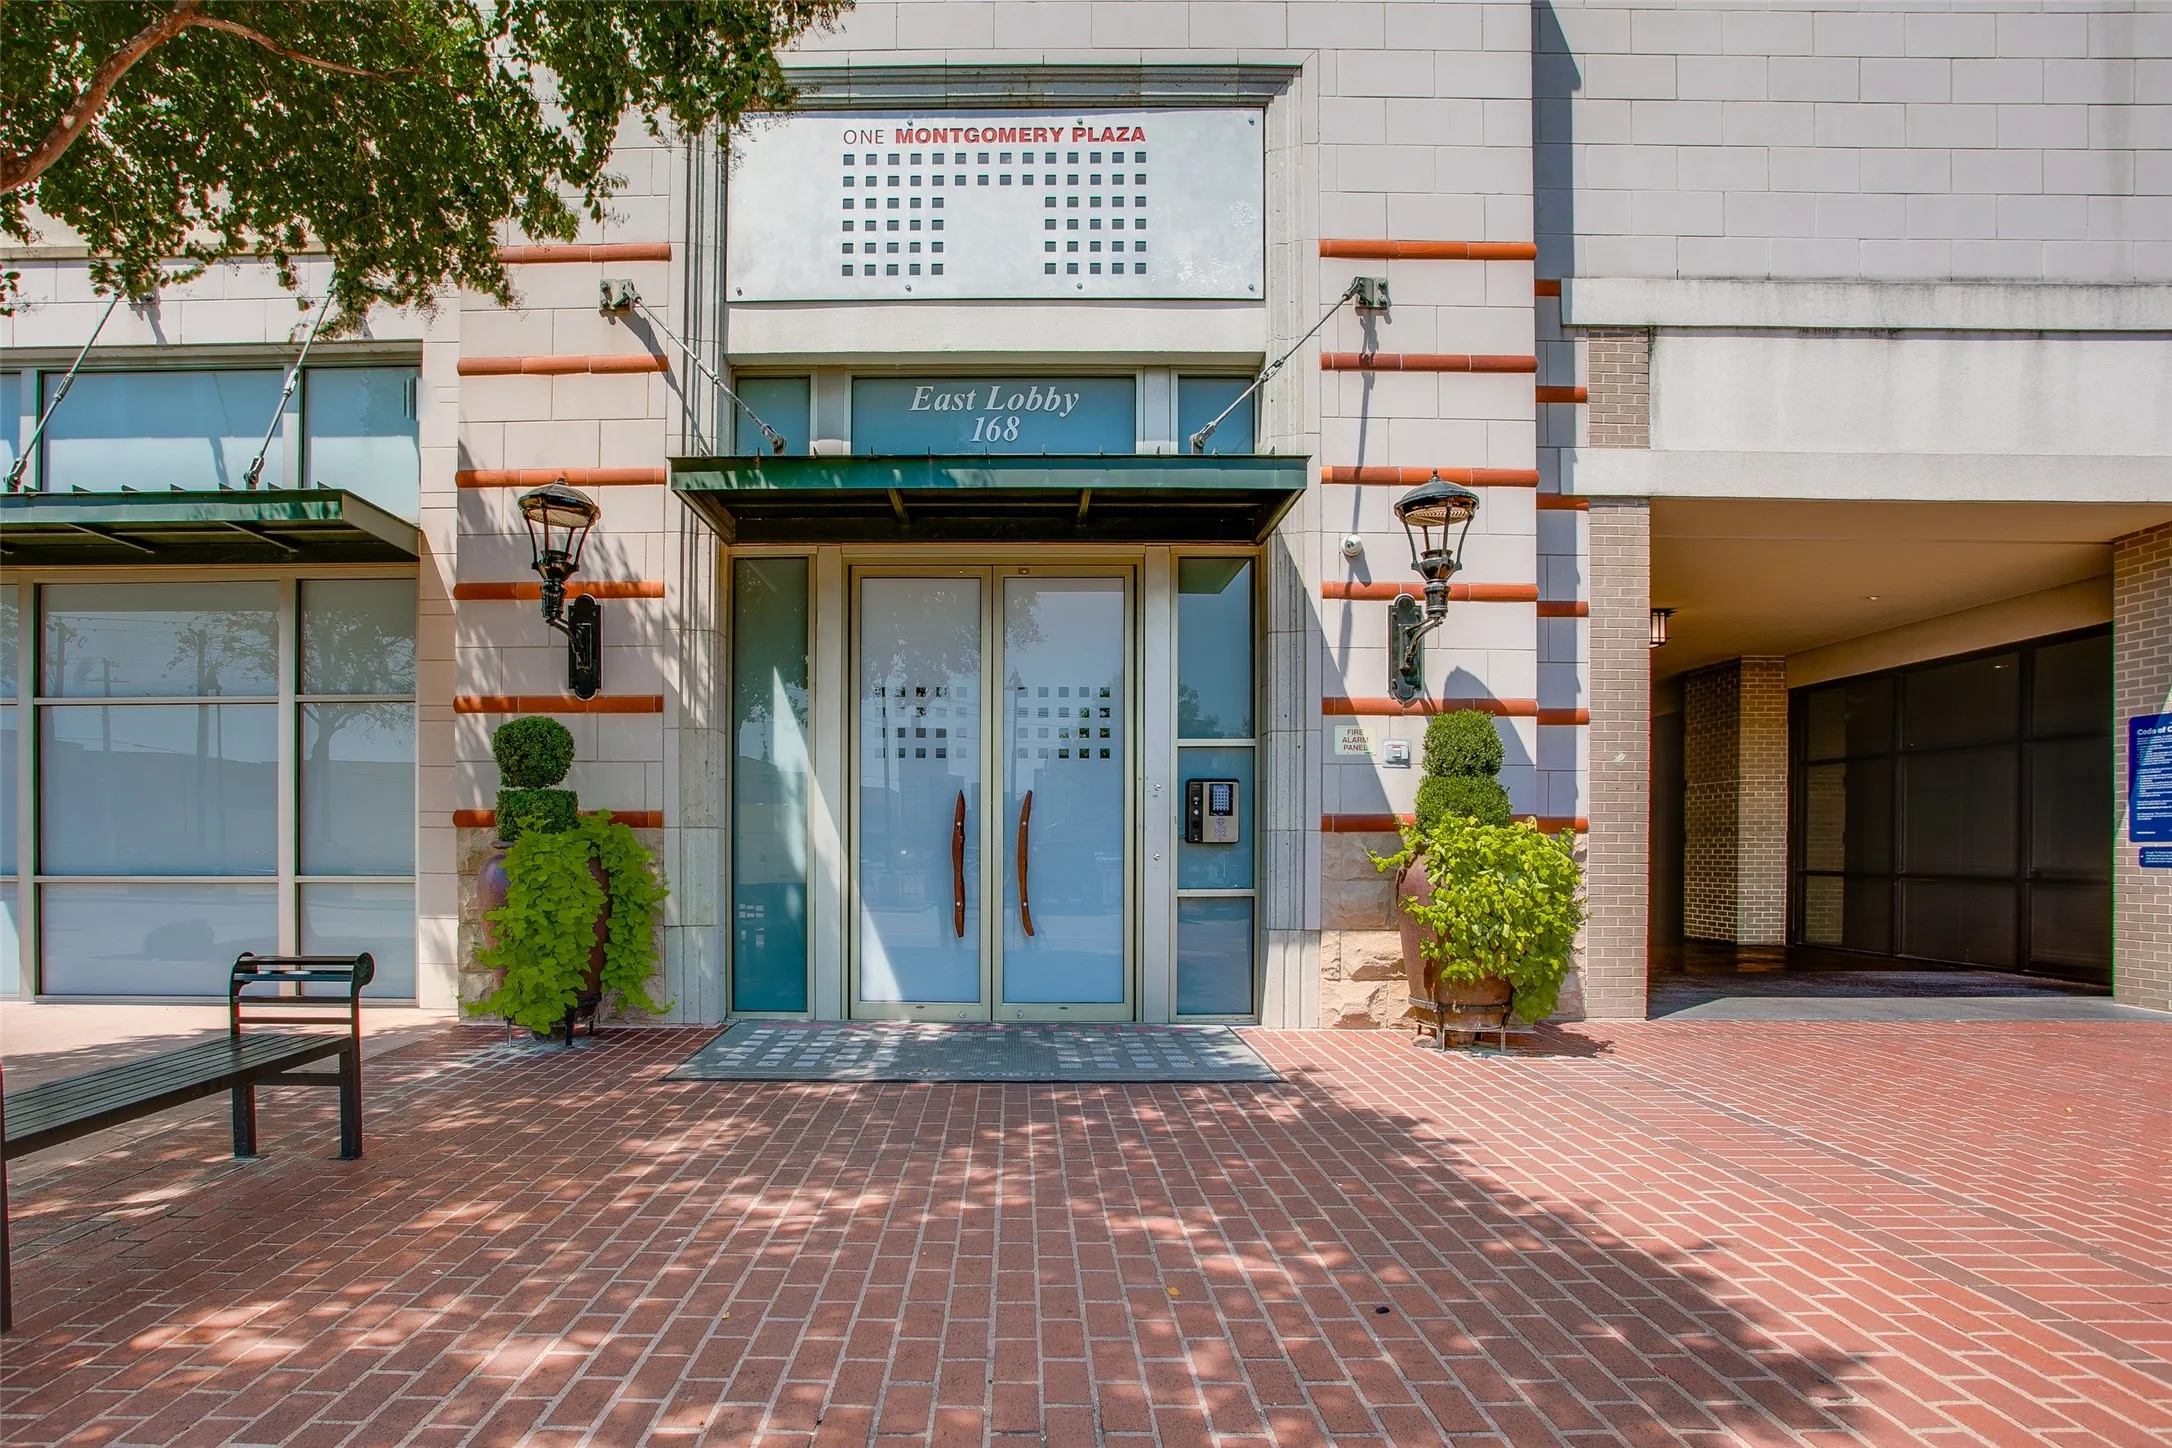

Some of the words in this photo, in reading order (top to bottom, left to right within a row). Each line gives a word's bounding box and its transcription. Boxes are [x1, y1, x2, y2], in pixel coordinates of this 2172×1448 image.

[843, 129, 884, 145] ONE
[895, 127, 1064, 144] MONTGOMERY
[1072, 126, 1146, 143] PLAZA
[909, 385, 977, 412] East
[984, 385, 1080, 418] Lobby
[970, 416, 1021, 443] 168
